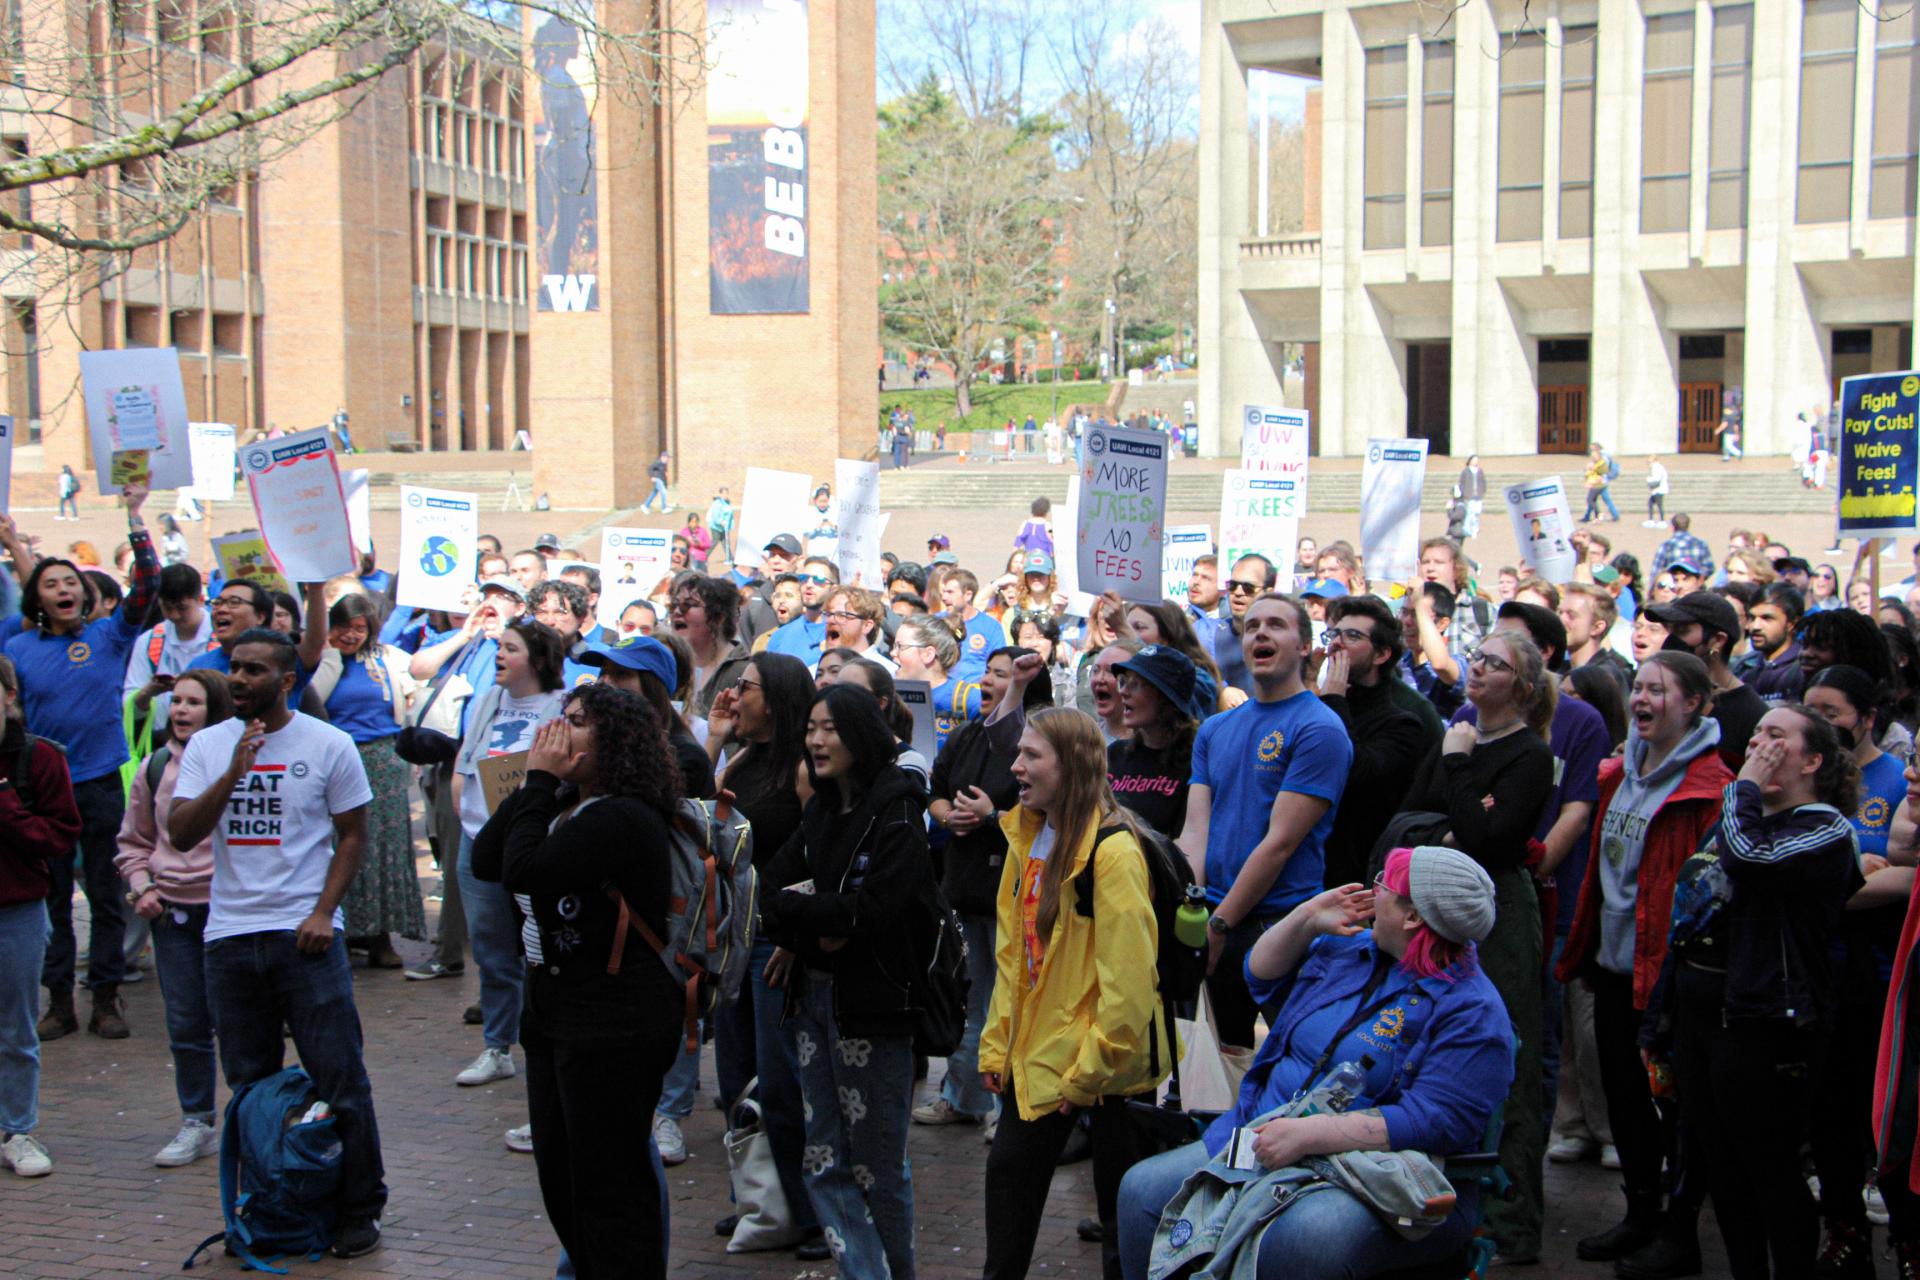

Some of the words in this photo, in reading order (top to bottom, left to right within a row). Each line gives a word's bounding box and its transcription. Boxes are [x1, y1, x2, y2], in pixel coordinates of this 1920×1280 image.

[764, 177, 804, 257] BE
[543, 274, 596, 313] W
[1860, 391, 1898, 412] Fight
[1260, 425, 1293, 444] UW
[1845, 417, 1872, 436] Pay
[1874, 413, 1914, 432] Cuts!
[310, 439, 325, 450] 4121
[1111, 442, 1127, 452] UAW
[1128, 444, 1145, 454] Local
[1145, 447, 1160, 456] 4121
[1854, 442, 1902, 459] Waive
[1096, 461, 1151, 493] MORE
[1857, 463, 1897, 481] Fees!
[1090, 490, 1155, 524] TREES
[1233, 495, 1296, 518] TREES
[1103, 527, 1132, 553] NO
[1095, 549, 1142, 582] FEES
[234, 774, 284, 793] EAT
[230, 797, 283, 816] THE
[228, 819, 281, 836] RICH
